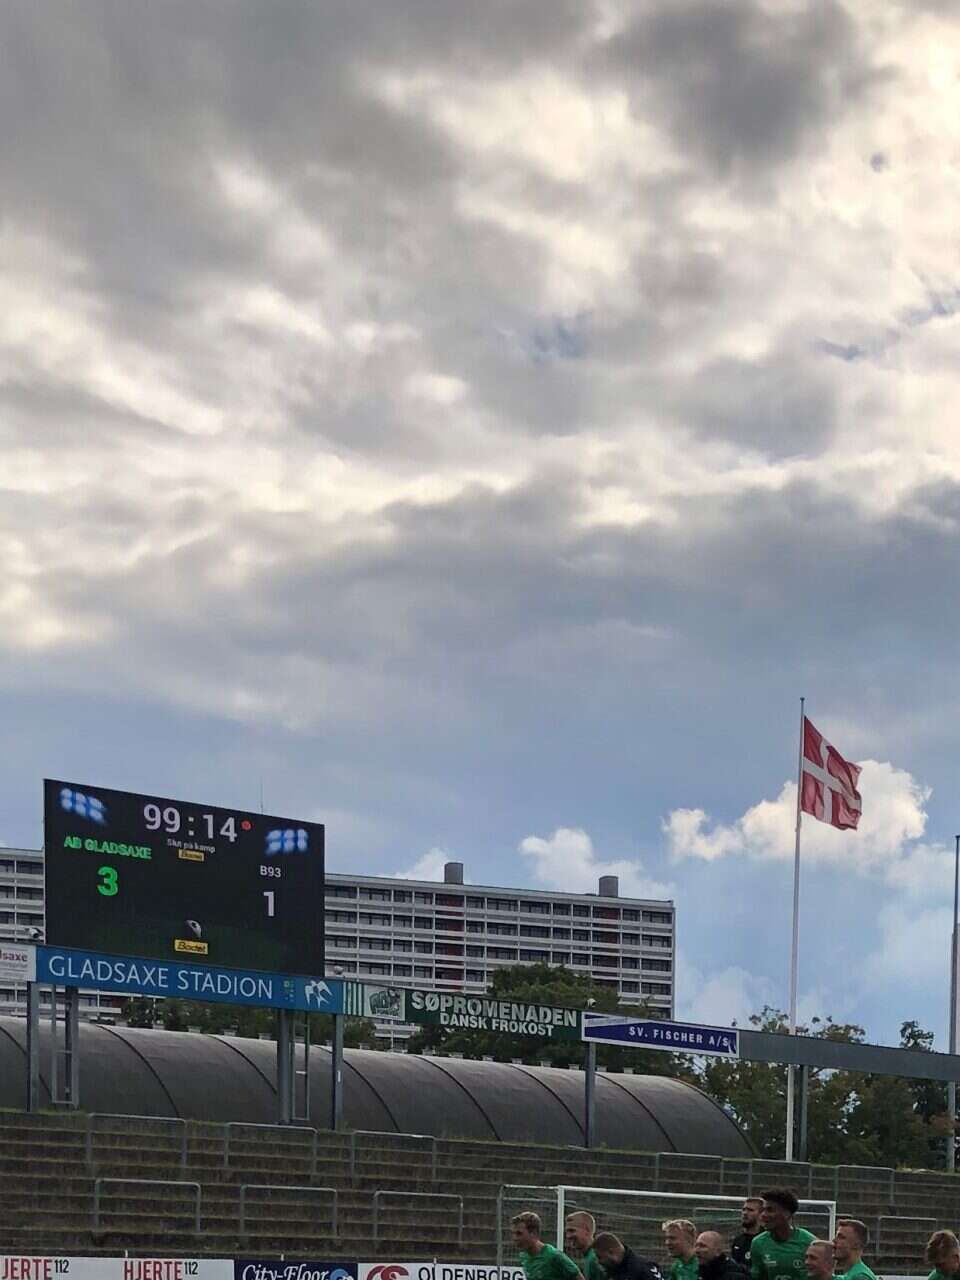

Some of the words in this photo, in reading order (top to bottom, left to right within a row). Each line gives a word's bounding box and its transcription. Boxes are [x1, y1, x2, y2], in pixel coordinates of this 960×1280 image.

[143, 803, 238, 842] 99:14
[64, 836, 82, 850] AB
[84, 838, 153, 860] GLADSAXE
[97, 866, 119, 896] 3
[259, 865, 282, 879] B93
[263, 891, 276, 917] 1
[48, 955, 169, 989] GLADSAXE
[177, 969, 273, 1000] STADION
[411, 990, 577, 1028] SØPROMENADEN
[439, 1012, 488, 1031] DANSK
[491, 1018, 555, 1038] FROKOST
[629, 1026, 649, 1038] SV.
[653, 1028, 703, 1044] FISCHER
[708, 1035, 729, 1047] A/S
[54, 1259, 70, 1274] 112
[184, 1261, 199, 1275] 112
